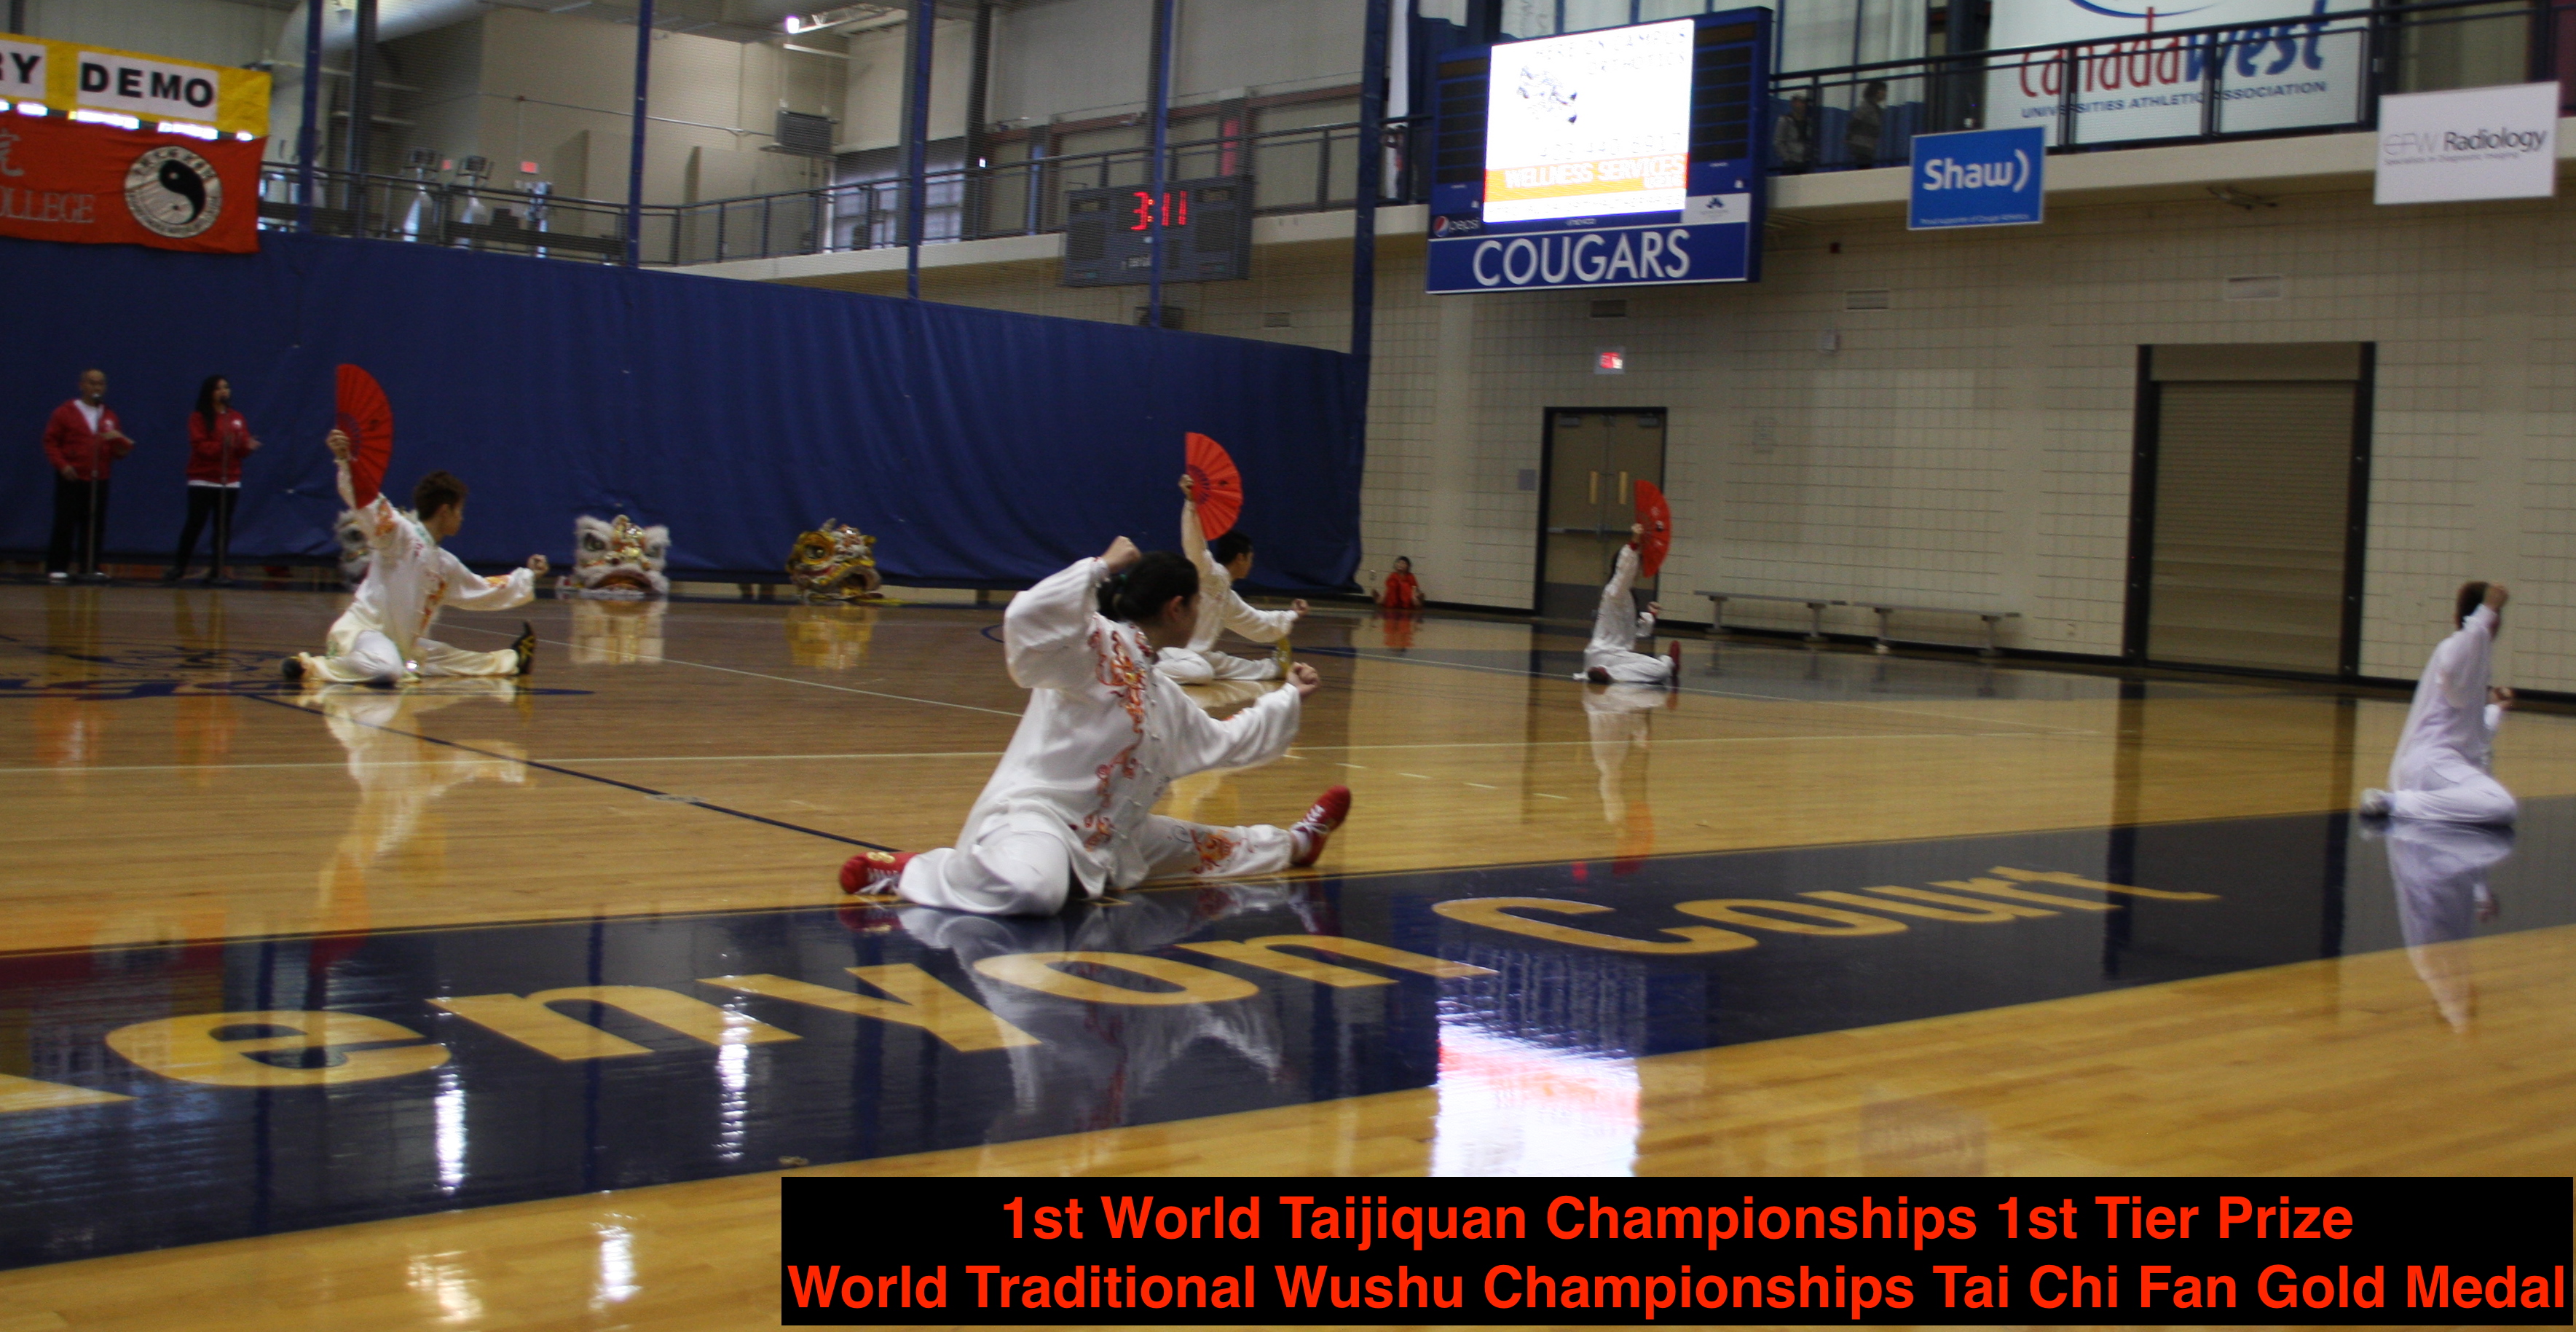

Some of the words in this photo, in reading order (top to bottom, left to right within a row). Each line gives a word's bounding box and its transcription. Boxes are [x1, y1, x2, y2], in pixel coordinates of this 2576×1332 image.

[81, 61, 214, 108] DEMO
[2443, 127, 2548, 152] Radiology
[1504, 162, 1594, 189] WELLNESS
[1598, 154, 1685, 181] SERVICES
[1473, 229, 1690, 287] COUGARS
[1431, 866, 2221, 955] Court
